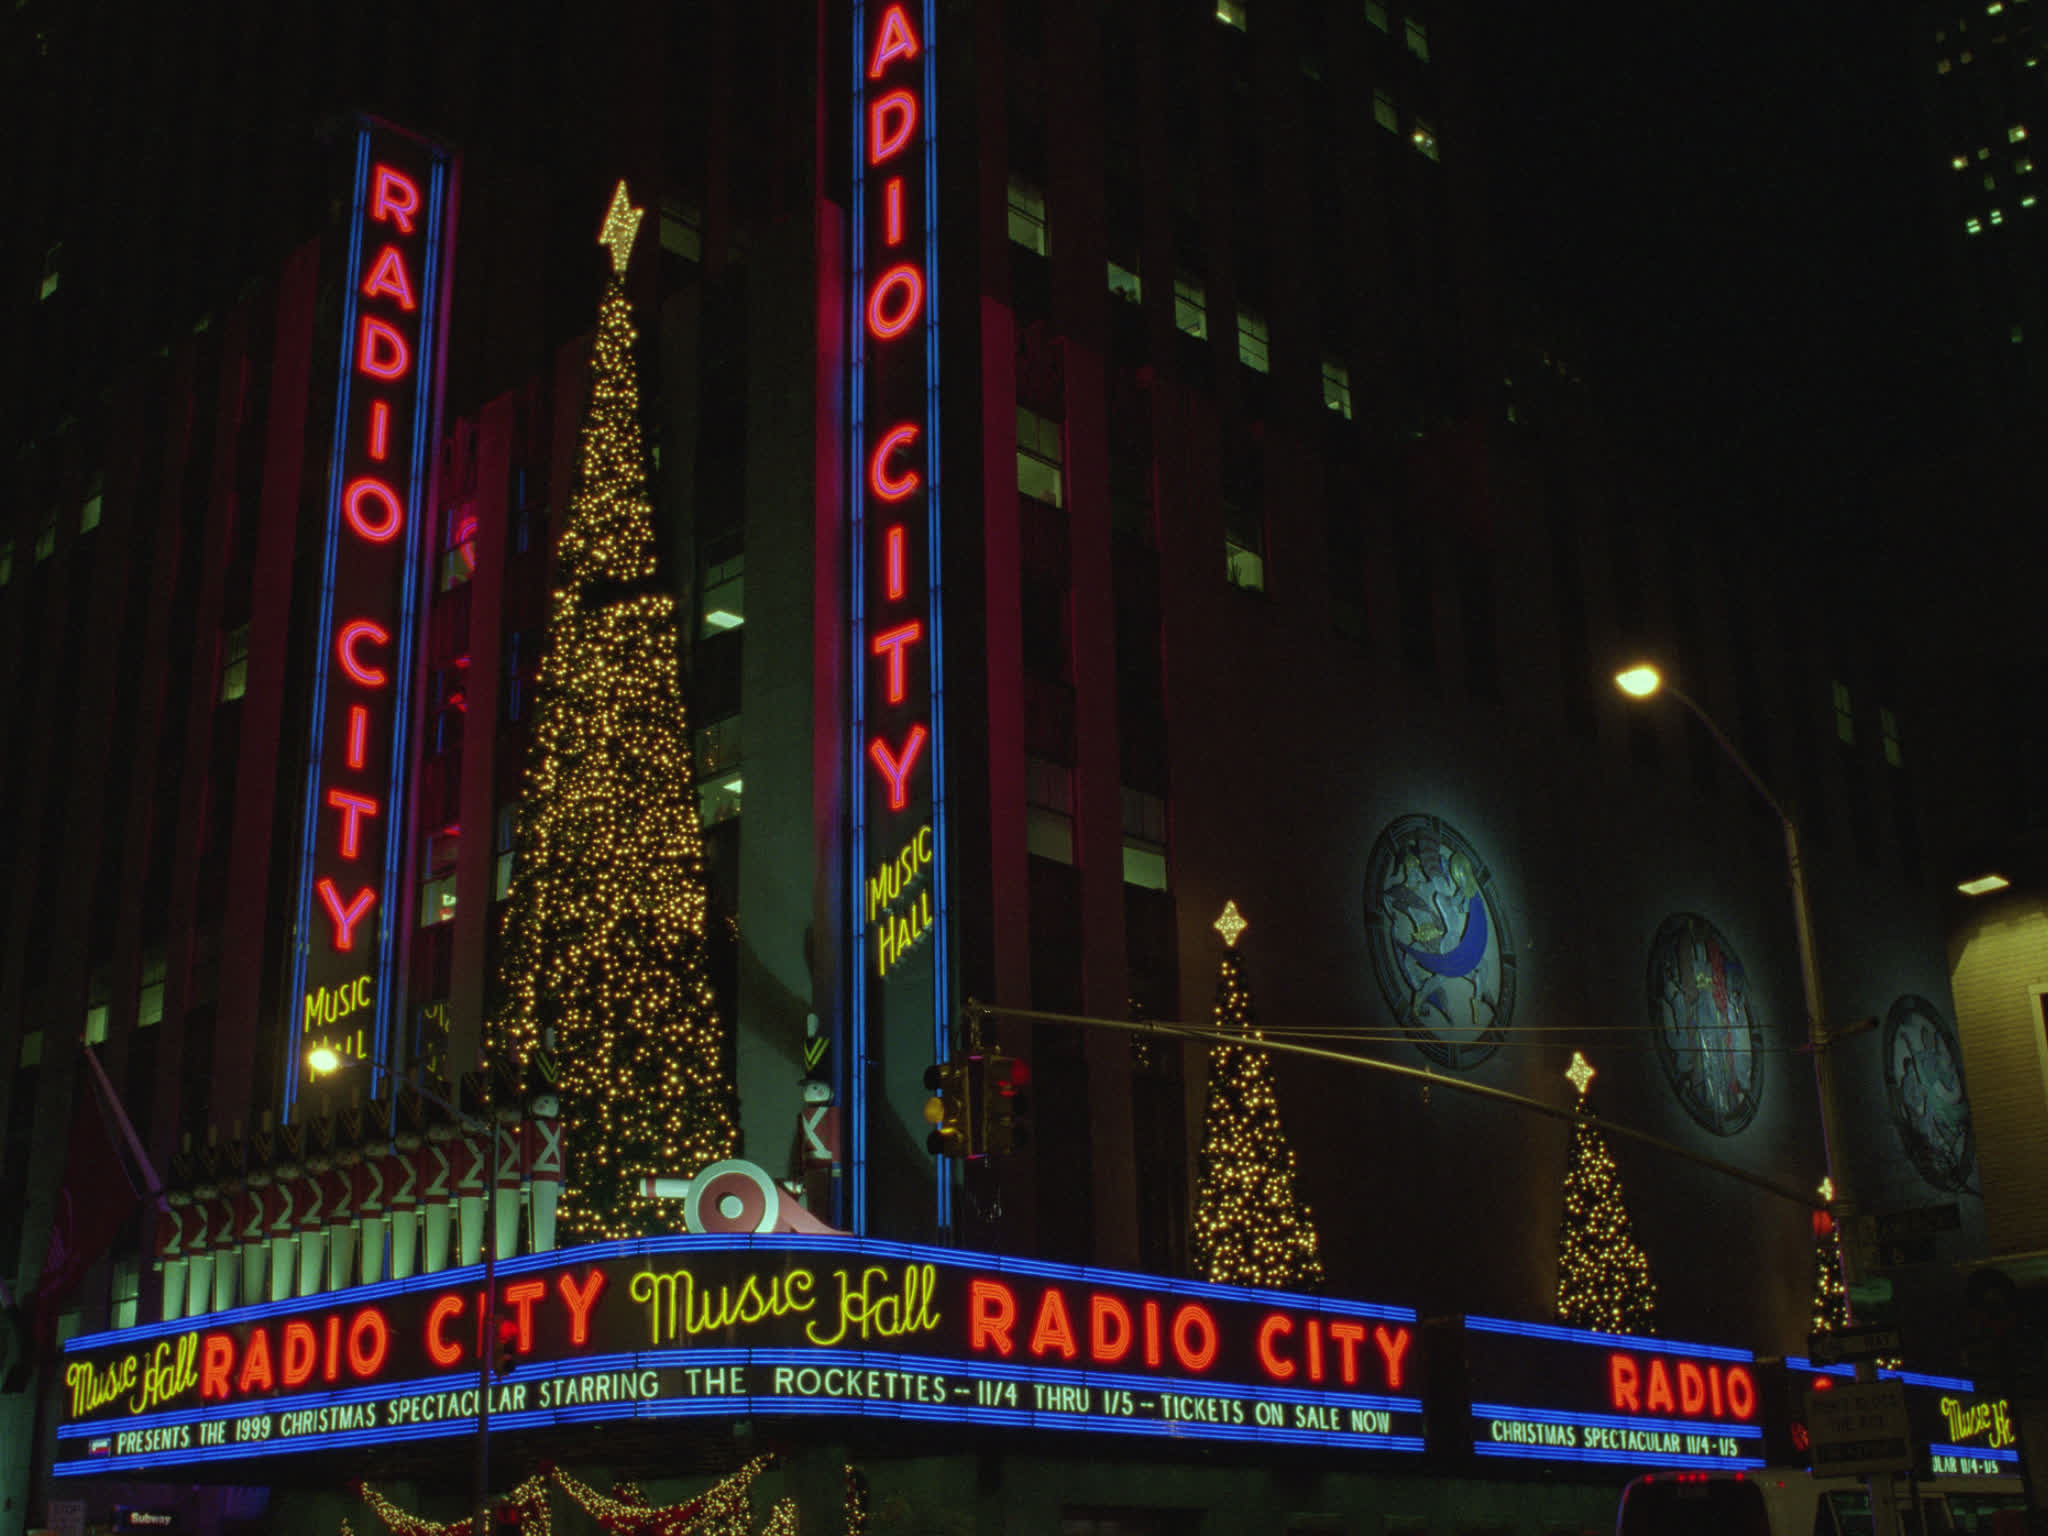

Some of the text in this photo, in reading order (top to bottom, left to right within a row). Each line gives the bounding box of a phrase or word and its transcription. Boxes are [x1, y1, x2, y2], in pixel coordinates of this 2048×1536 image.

[317, 162, 419, 950] RADIO CITY
[869, 424, 926, 810] CITY
[865, 825, 932, 922] MUSIC
[879, 888, 932, 976] HALL
[305, 975, 371, 1032] MUSIC
[631, 1264, 940, 1345] Music Hall
[971, 1279, 1409, 1388] RADIO CITY
[66, 1332, 198, 1418] Music Hall
[202, 1307, 388, 1398] RADIO
[1611, 1353, 1754, 1420] RADIO
[117, 1425, 190, 1455] PRESENTS
[200, 1421, 227, 1446] THE
[236, 1416, 271, 1441] 1999
[281, 1403, 376, 1437] CHRISTMAS
[540, 1371, 659, 1408] STARRING
[685, 1367, 746, 1396] THE
[1034, 1384, 1090, 1413] THRU
[1160, 1394, 1244, 1424] TICKETS
[1255, 1402, 1284, 1427] ON
[1296, 1405, 1341, 1431] SALE
[1352, 1409, 1390, 1434] NOW
[1491, 1419, 1576, 1447] CHRISTMAS
[1583, 1426, 1680, 1453] SPECTACULAR
[1941, 1396, 1991, 1443] Music
